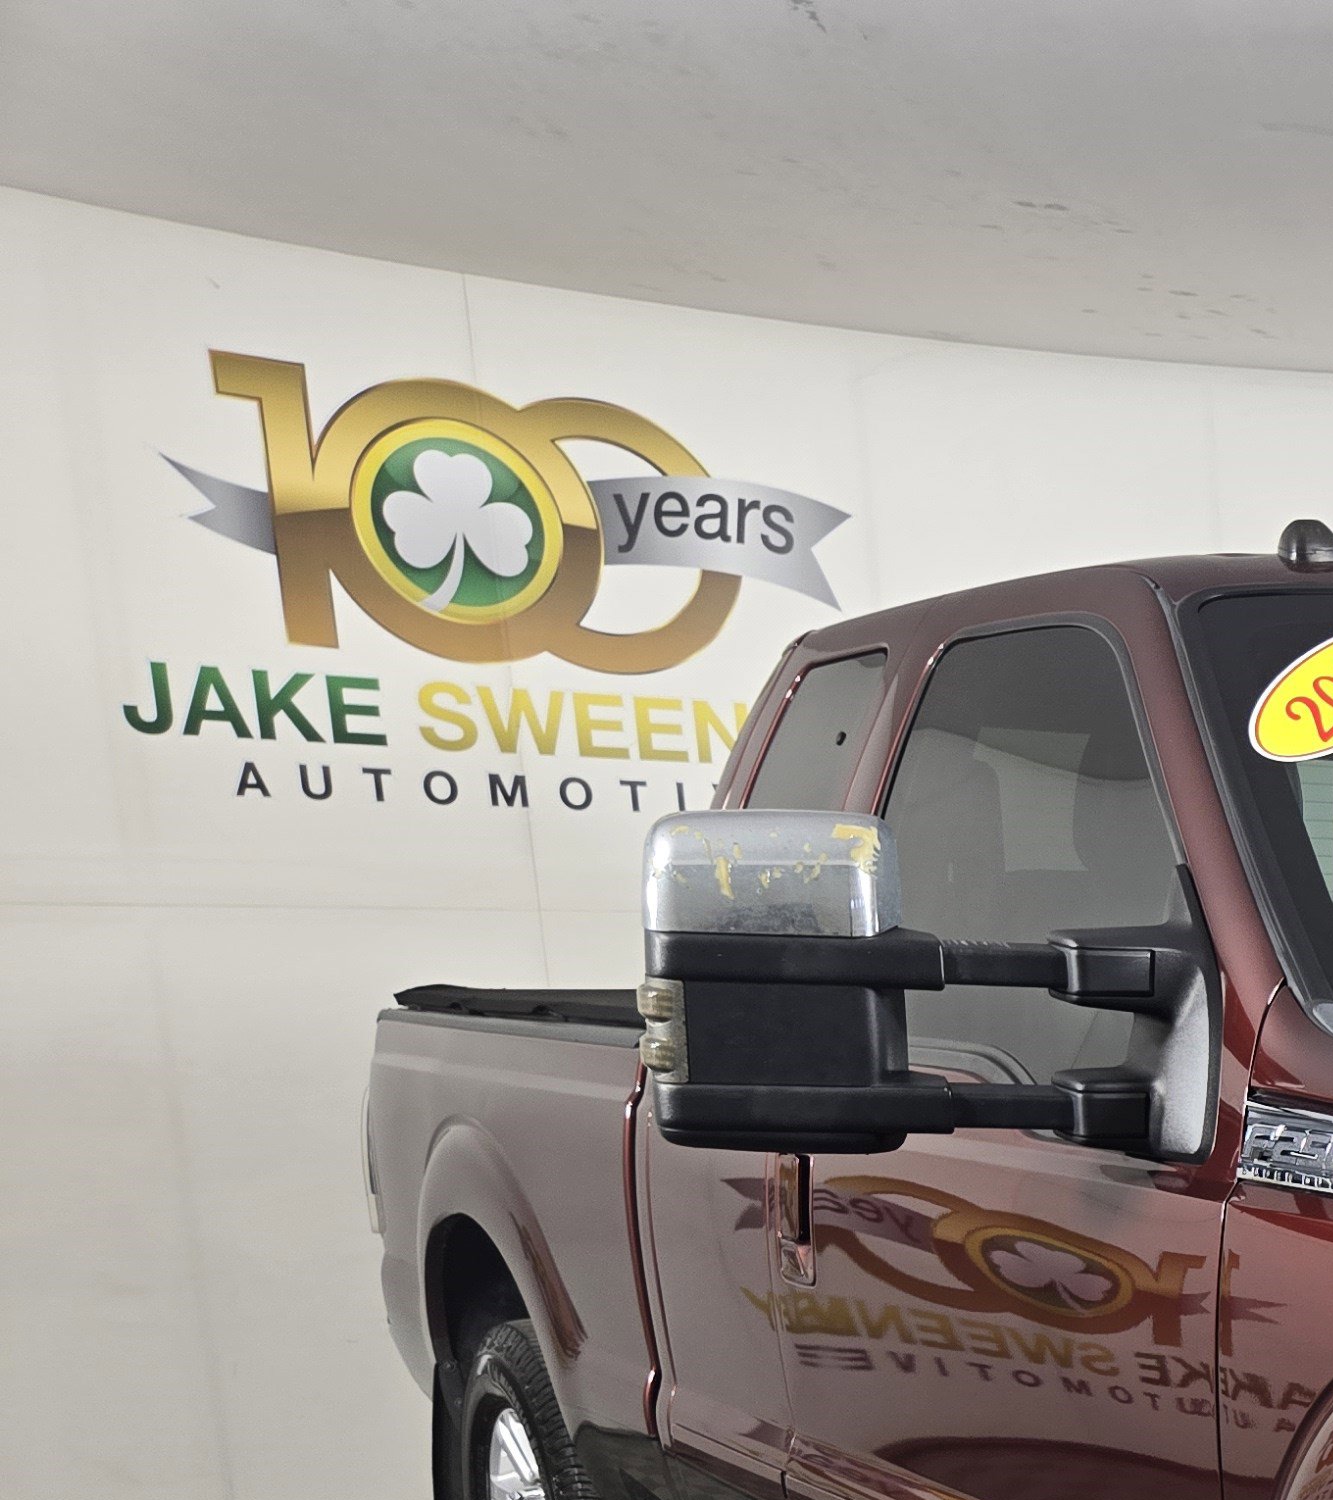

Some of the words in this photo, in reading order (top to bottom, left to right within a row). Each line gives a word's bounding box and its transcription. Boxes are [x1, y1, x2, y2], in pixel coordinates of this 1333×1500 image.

[612, 489, 796, 554] years
[123, 660, 389, 747] JAKE
[417, 681, 748, 764] SWEEN
[235, 761, 718, 812] AUTOMOTI
